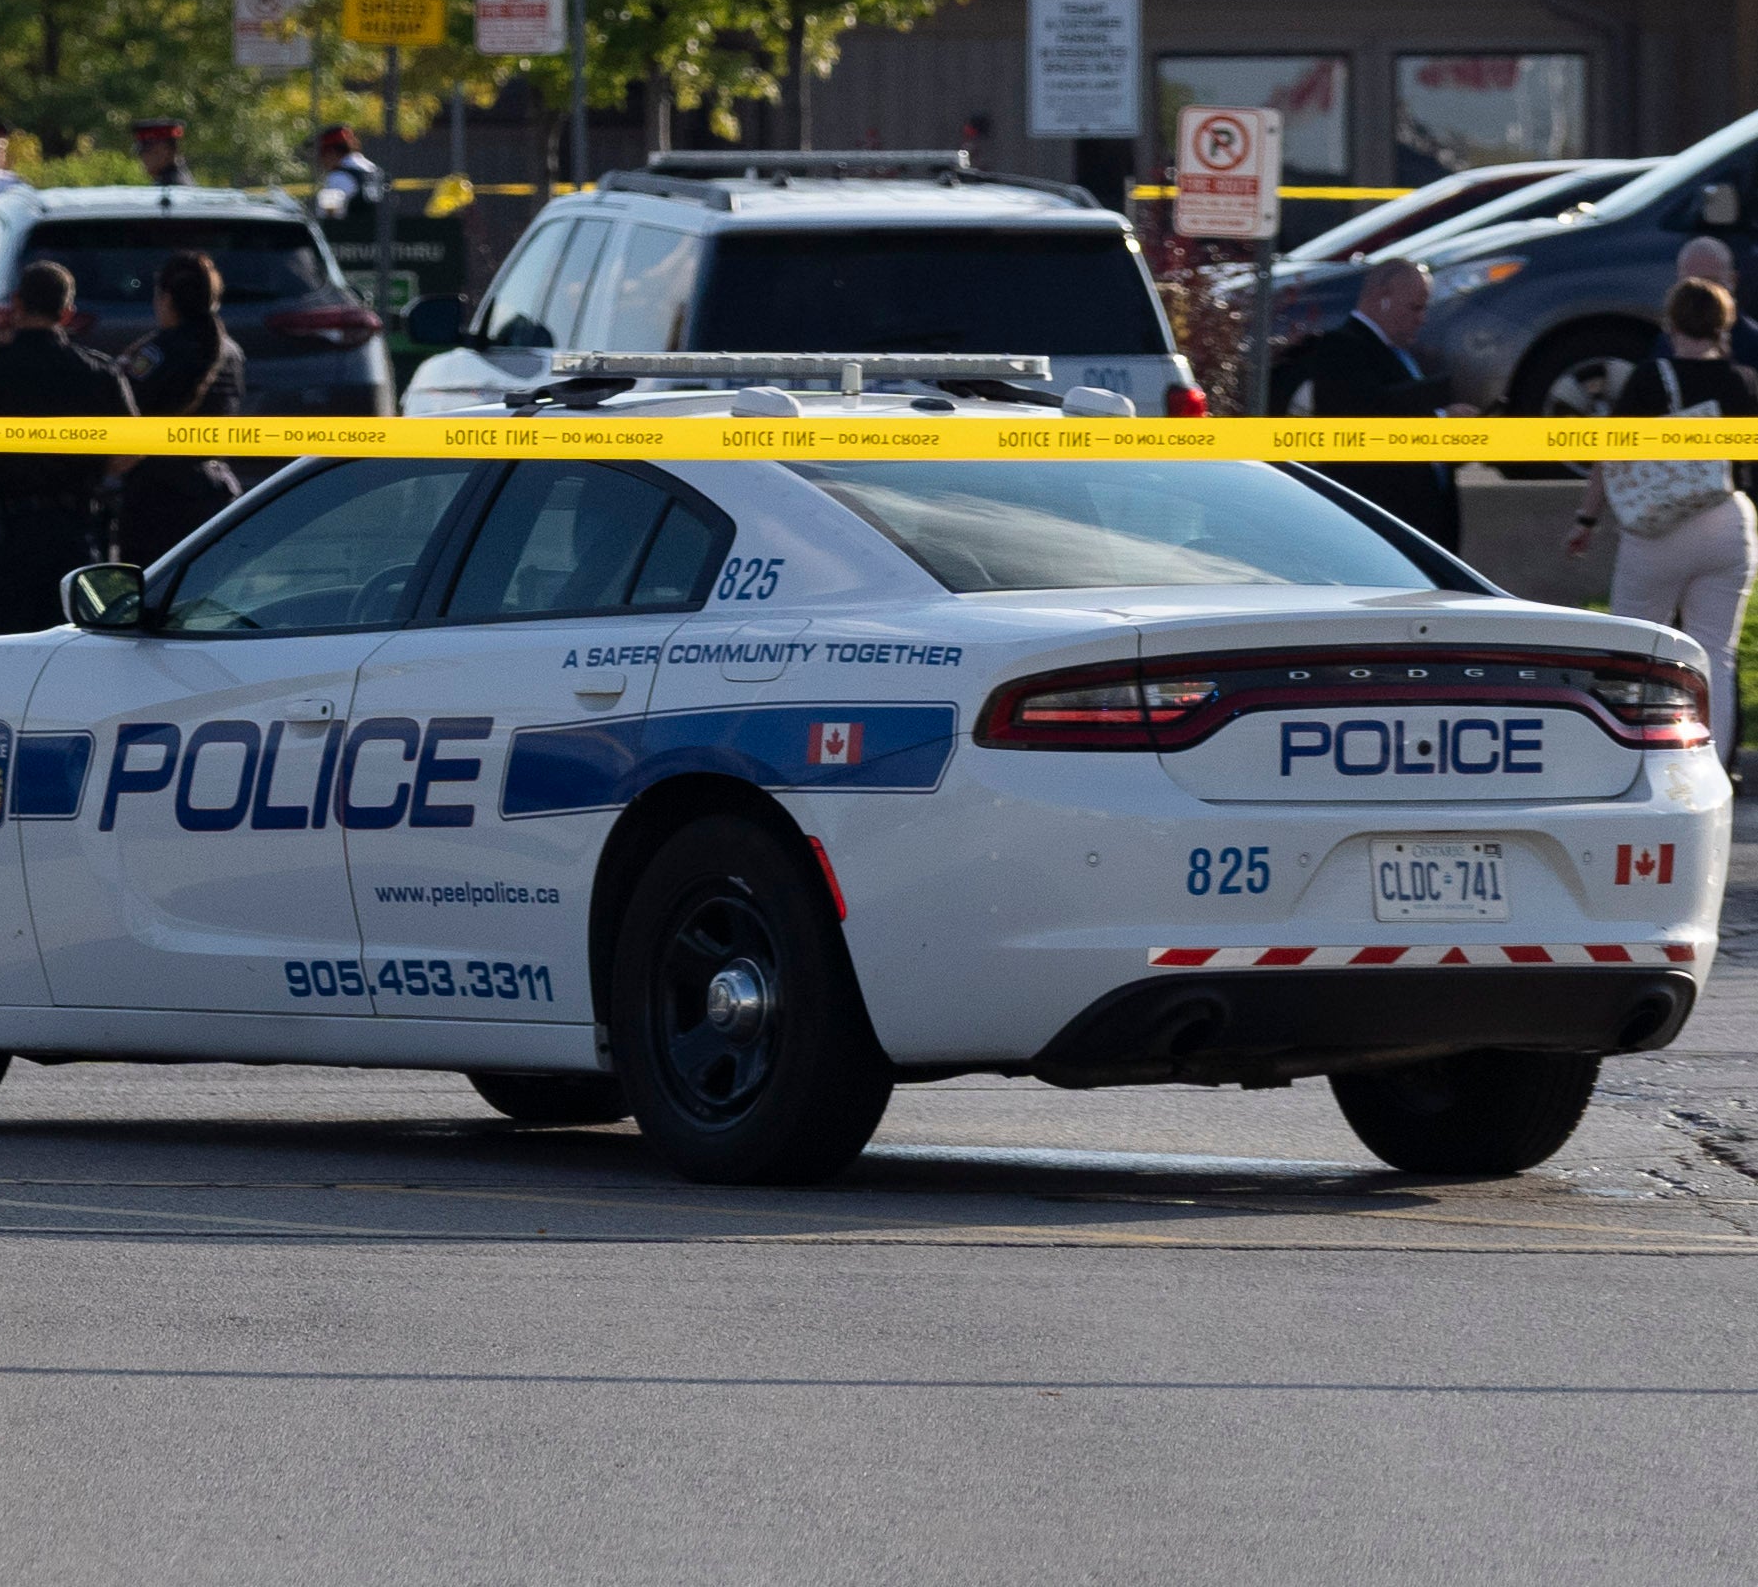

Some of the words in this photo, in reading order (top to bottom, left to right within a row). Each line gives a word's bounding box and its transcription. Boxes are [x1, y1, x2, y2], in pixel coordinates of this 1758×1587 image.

[717, 557, 784, 600] 825
[562, 649, 579, 669] A
[586, 645, 660, 668] SAFER
[668, 643, 818, 665] COMMUNITY
[825, 643, 963, 667] TOGETHER
[1288, 668, 1538, 680] DODGE
[1280, 718, 1544, 776] POLICE
[97, 716, 495, 832] POLICE
[1187, 846, 1270, 895] 825
[1380, 861, 1442, 901] CLDC
[1455, 861, 1502, 901] 741
[375, 881, 560, 907] www.peelpolice.ca
[285, 959, 554, 1002] 905.453.3311
